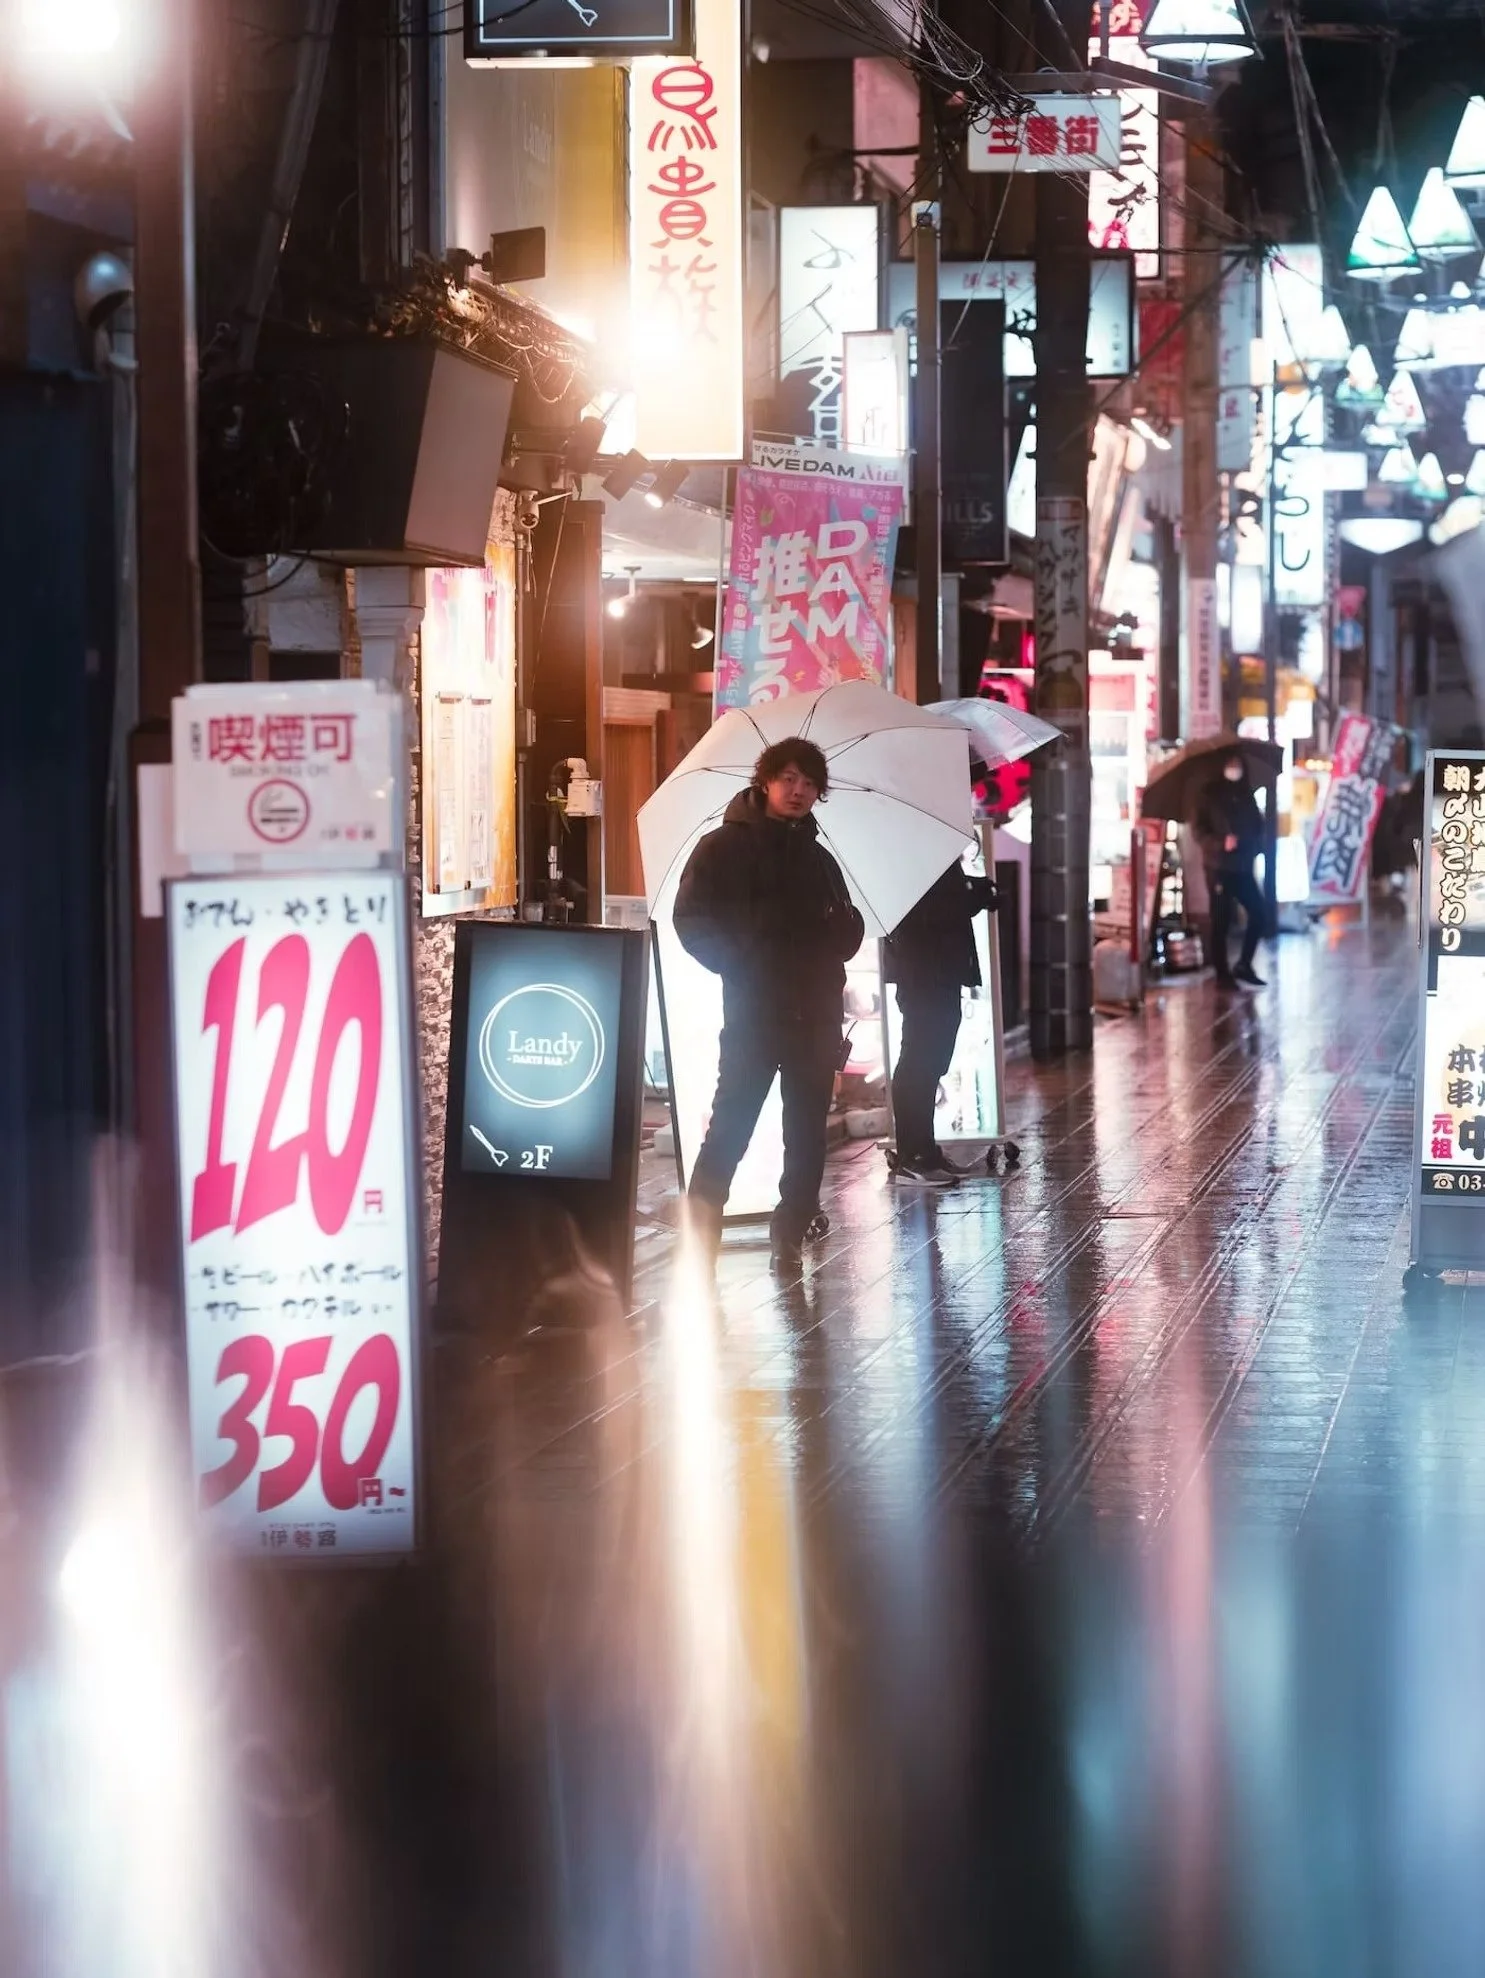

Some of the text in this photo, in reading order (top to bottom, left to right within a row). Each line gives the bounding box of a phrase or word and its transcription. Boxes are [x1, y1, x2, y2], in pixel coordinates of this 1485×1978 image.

[987, 115, 1100, 156] 三番街
[208, 713, 359, 763] 喫煙可
[1438, 764, 1471, 952] 朝〆のこだわり
[507, 1030, 584, 1063] Landy
[190, 931, 383, 1243] 120
[520, 1145, 553, 1170] 2F
[1430, 1113, 1453, 1160] 元祖
[199, 1332, 401, 1513] 350
